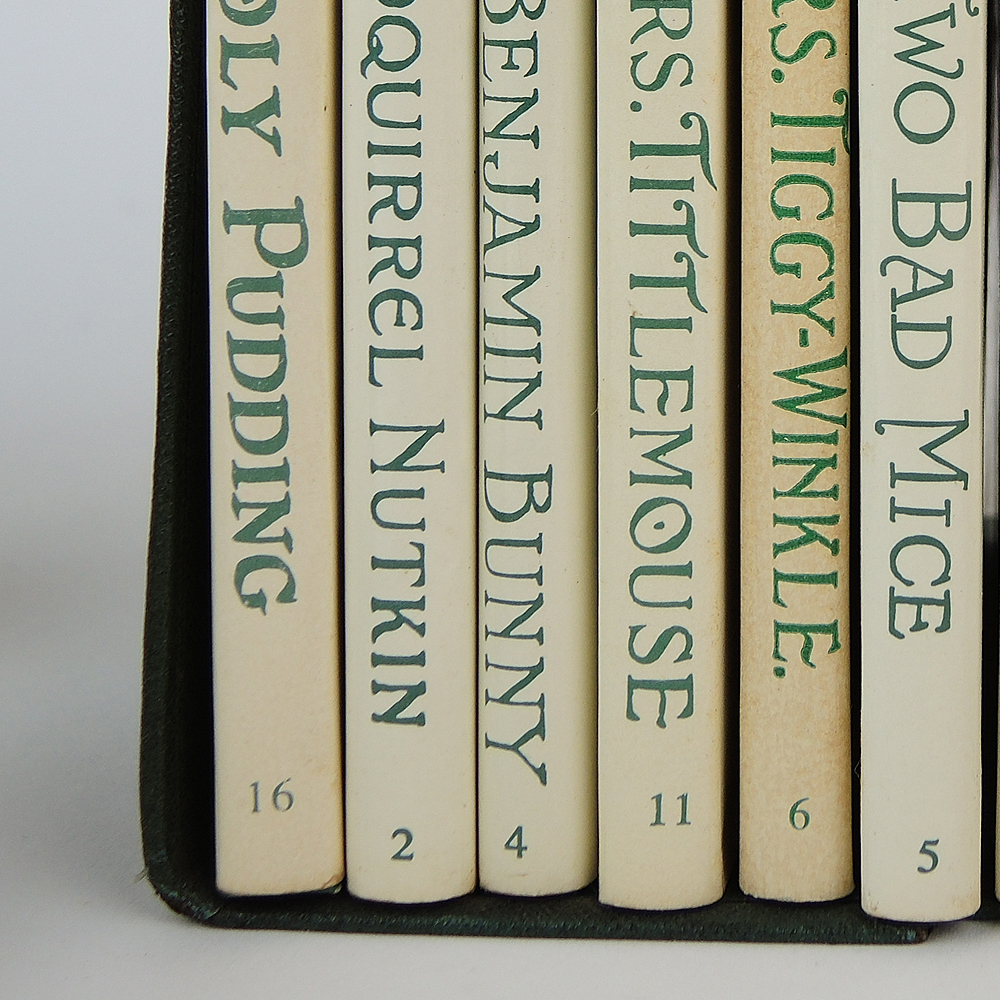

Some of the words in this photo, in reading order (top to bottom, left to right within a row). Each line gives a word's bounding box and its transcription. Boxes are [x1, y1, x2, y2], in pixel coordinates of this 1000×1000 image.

[880, 179, 972, 369] BAD
[223, 196, 308, 615] PUDDING
[873, 409, 969, 639] MICE
[369, 419, 444, 726] NUTKIN
[484, 460, 553, 786] BUNNY
[250, 778, 293, 813] 16
[650, 793, 691, 826] 11
[790, 798, 810, 830] 6
[391, 828, 414, 861] 2
[505, 826, 527, 858] 4
[918, 839, 939, 873] 5
